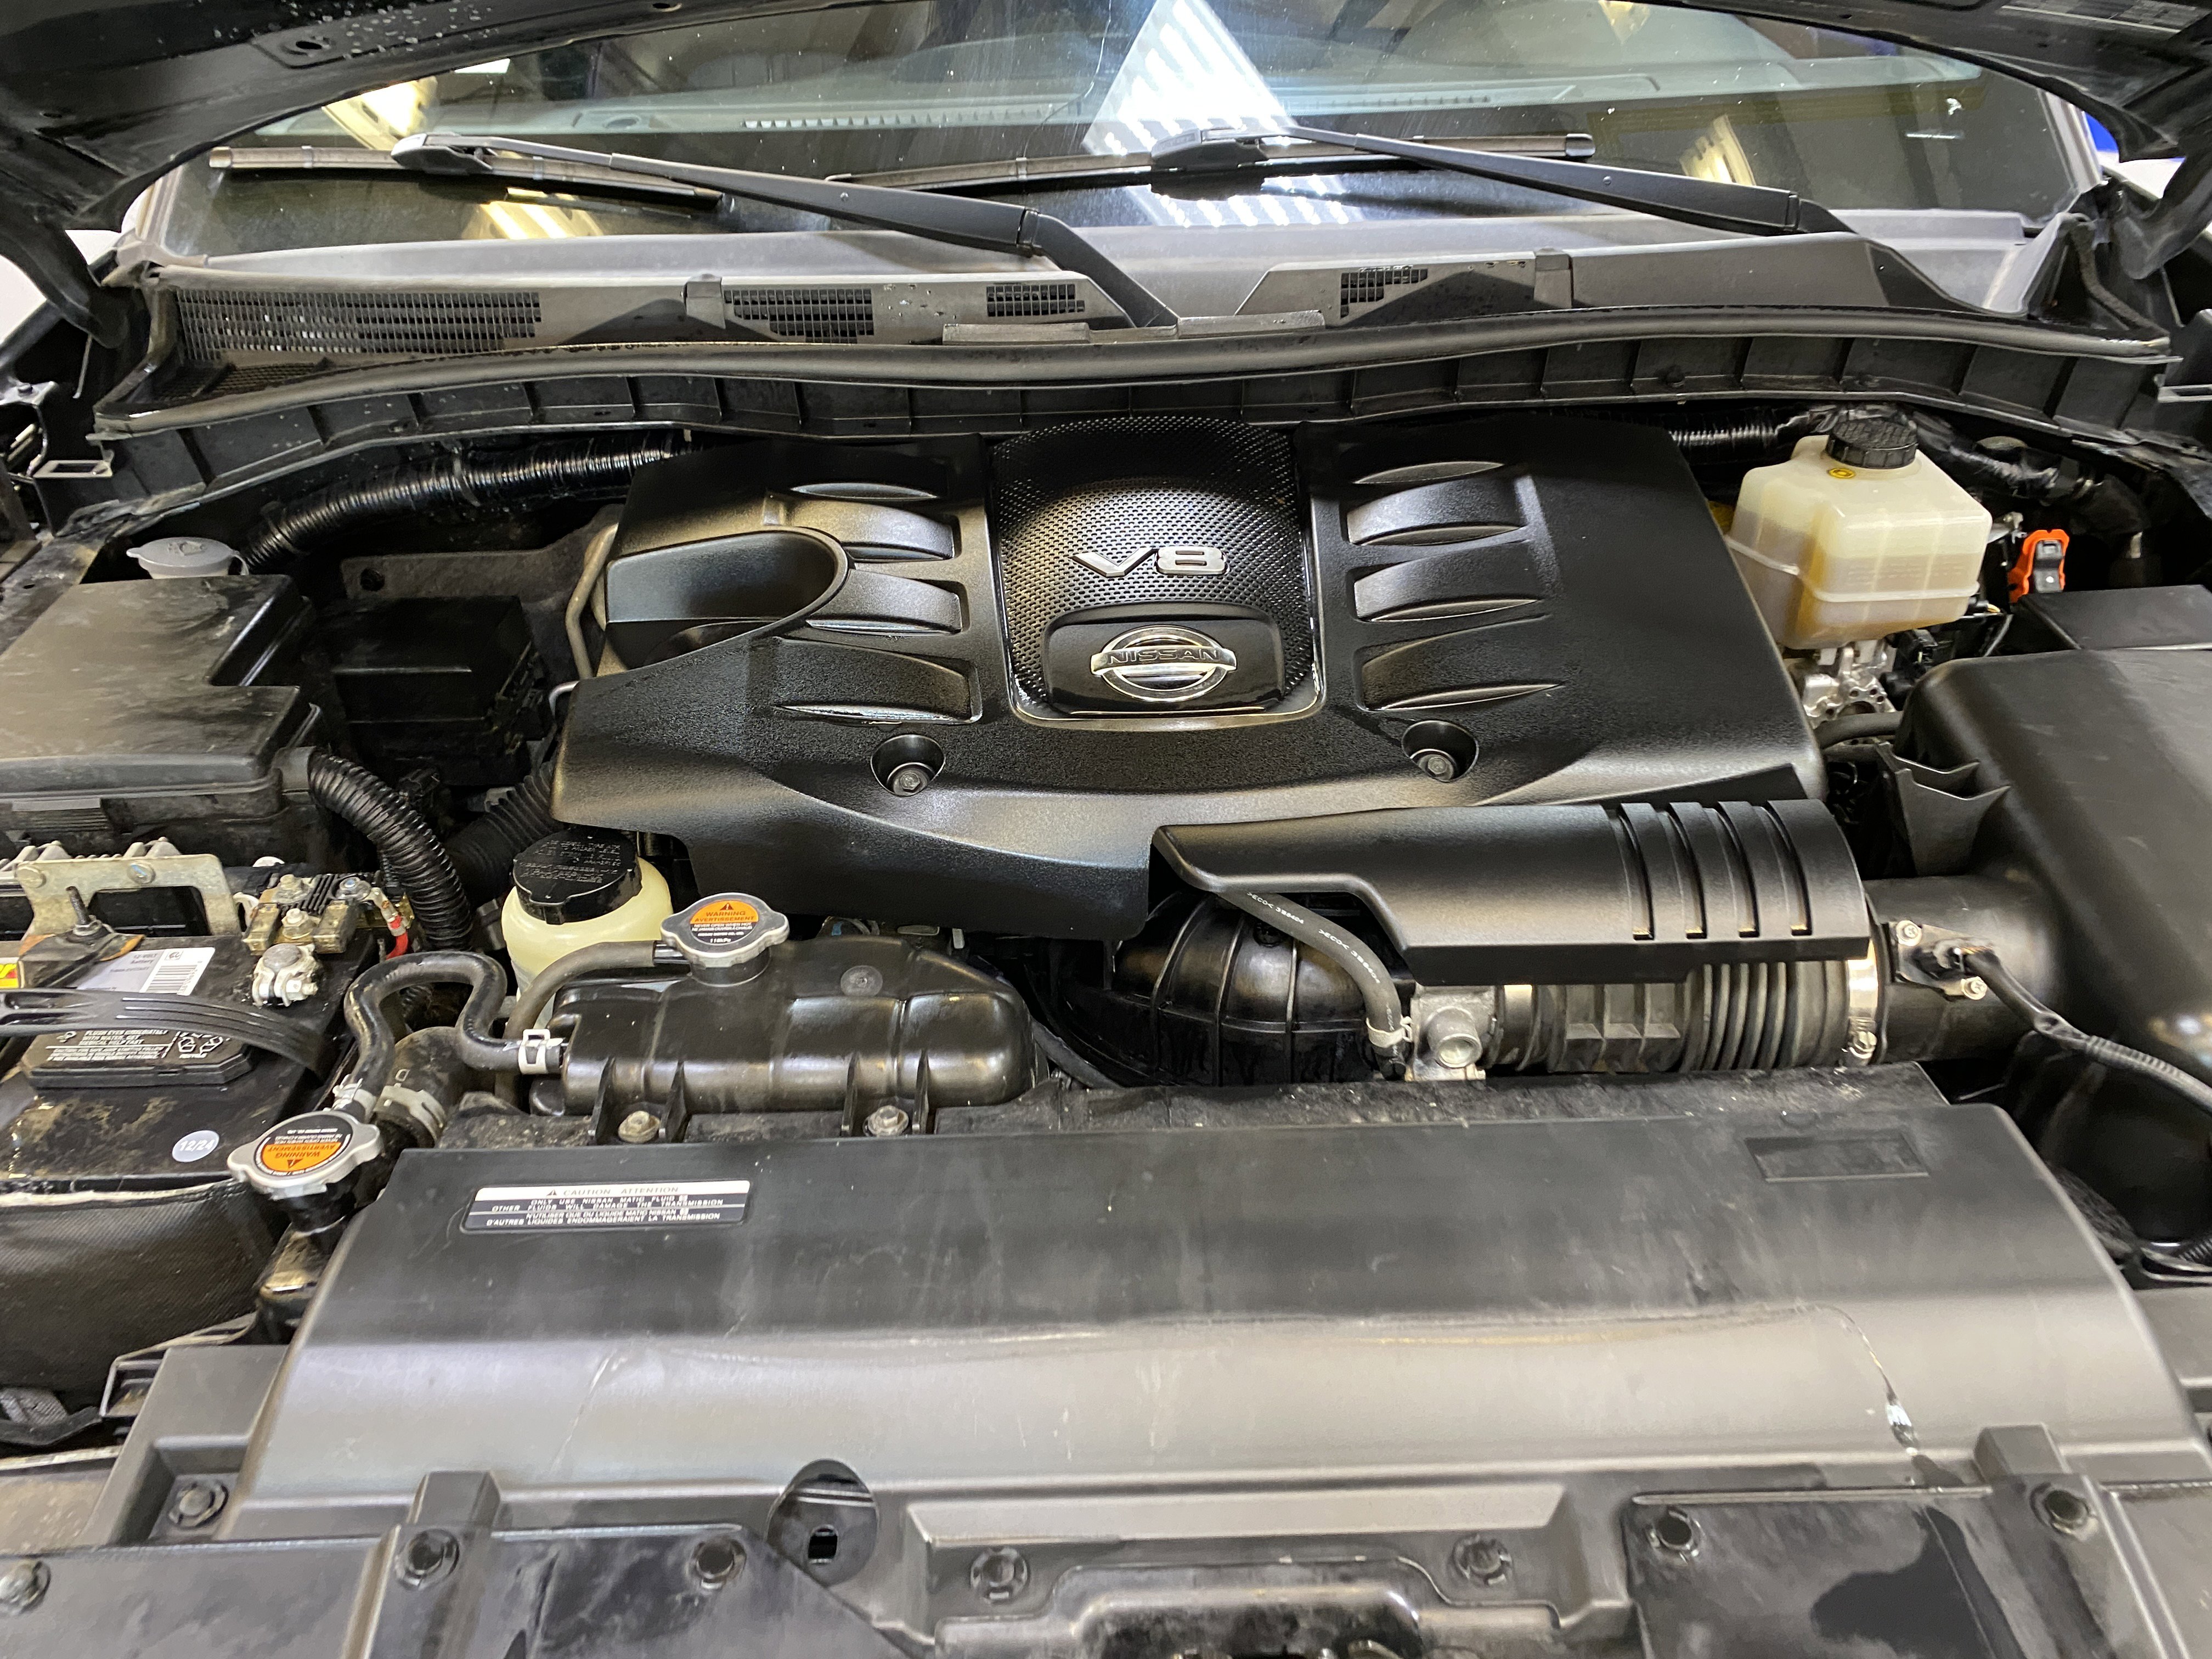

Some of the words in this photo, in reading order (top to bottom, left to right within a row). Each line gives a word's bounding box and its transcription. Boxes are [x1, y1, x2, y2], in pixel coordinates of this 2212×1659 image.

[1073, 546, 1227, 577] V8
[1107, 647, 1218, 664] NISSAN
[180, 1139, 215, 1152] 12/24
[275, 1150, 320, 1159] WARNING
[661, 1199, 724, 1207] TRANSMISSION
